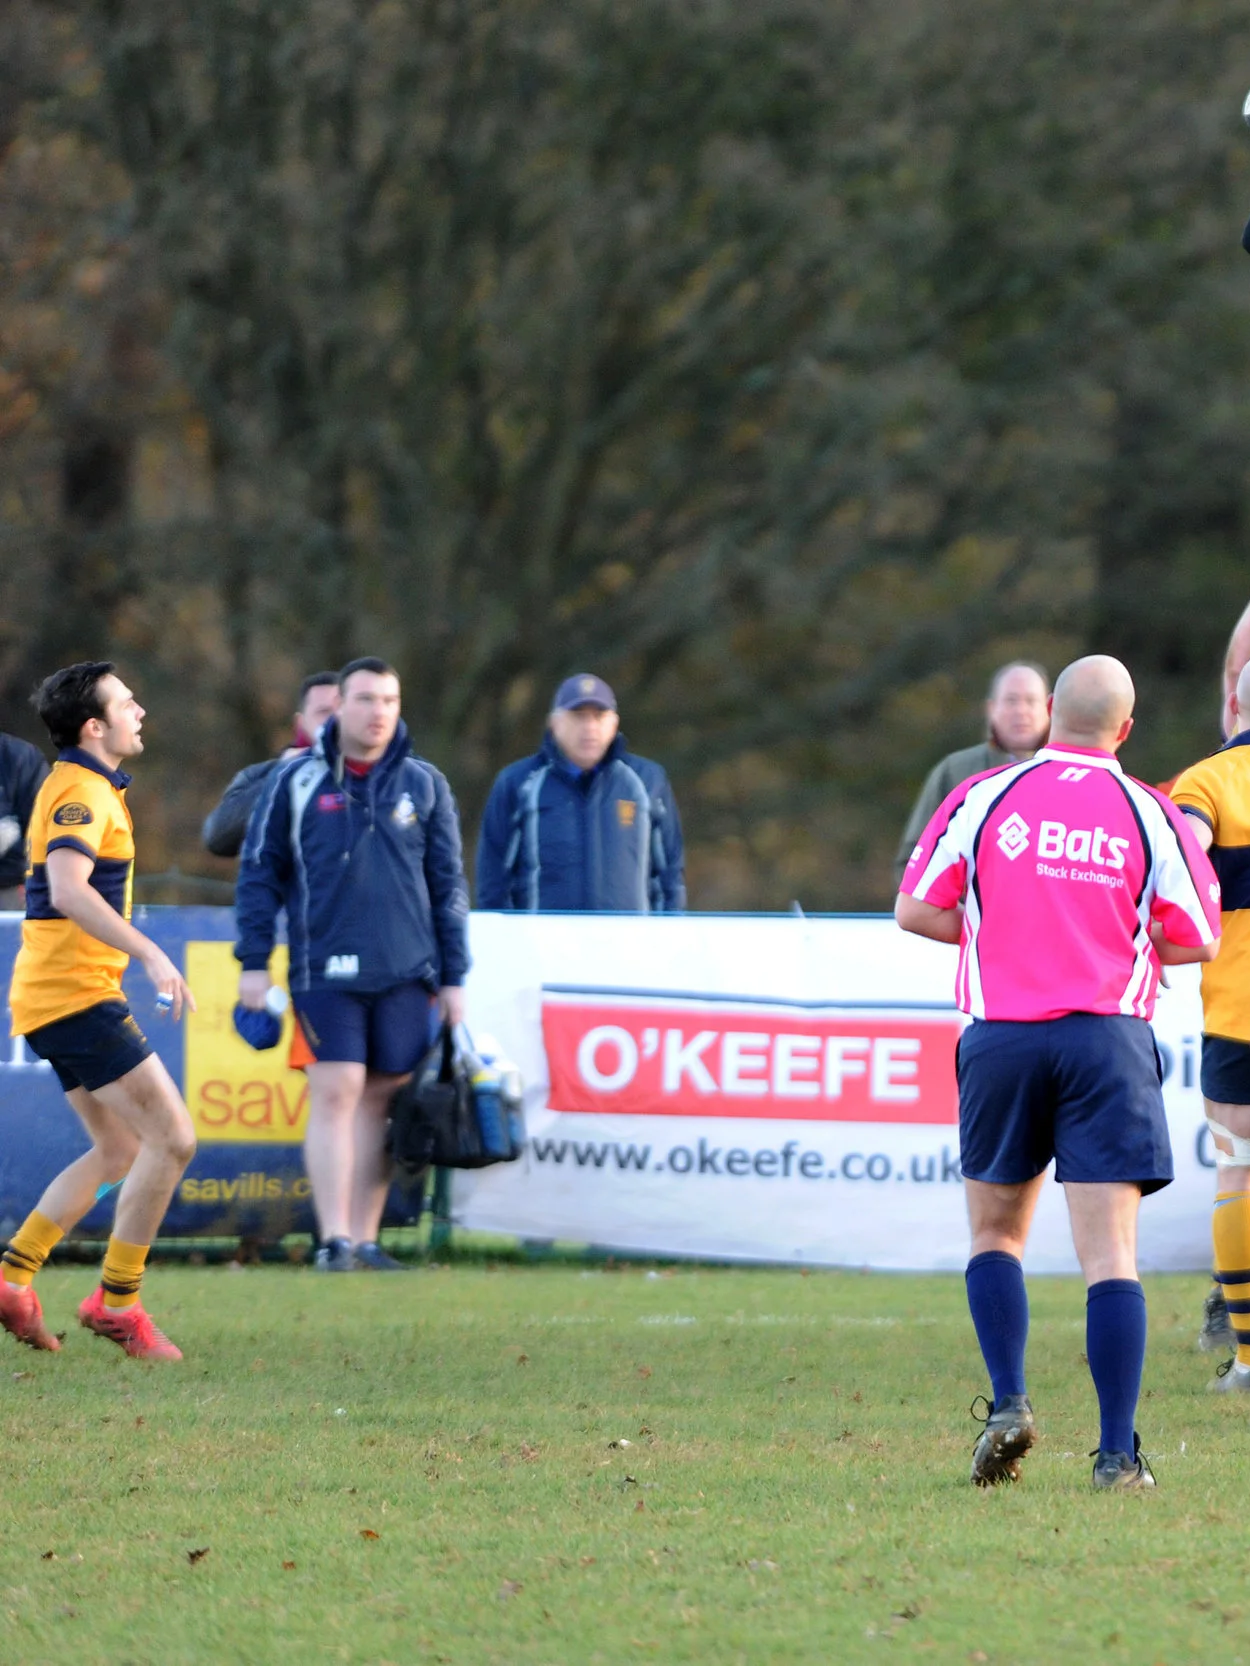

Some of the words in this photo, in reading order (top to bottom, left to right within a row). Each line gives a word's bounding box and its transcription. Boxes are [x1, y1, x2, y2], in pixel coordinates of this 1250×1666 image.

[1036, 820, 1130, 870] Bats
[1036, 862, 1069, 880] Stock
[1070, 868, 1125, 889] Exchange
[326, 955, 359, 977] AM
[576, 1025, 921, 1101] O'KEEFE
[198, 1078, 312, 1127] sav
[533, 1137, 963, 1182] www.okeefe.co.uk
[181, 1171, 313, 1201] savills.c
